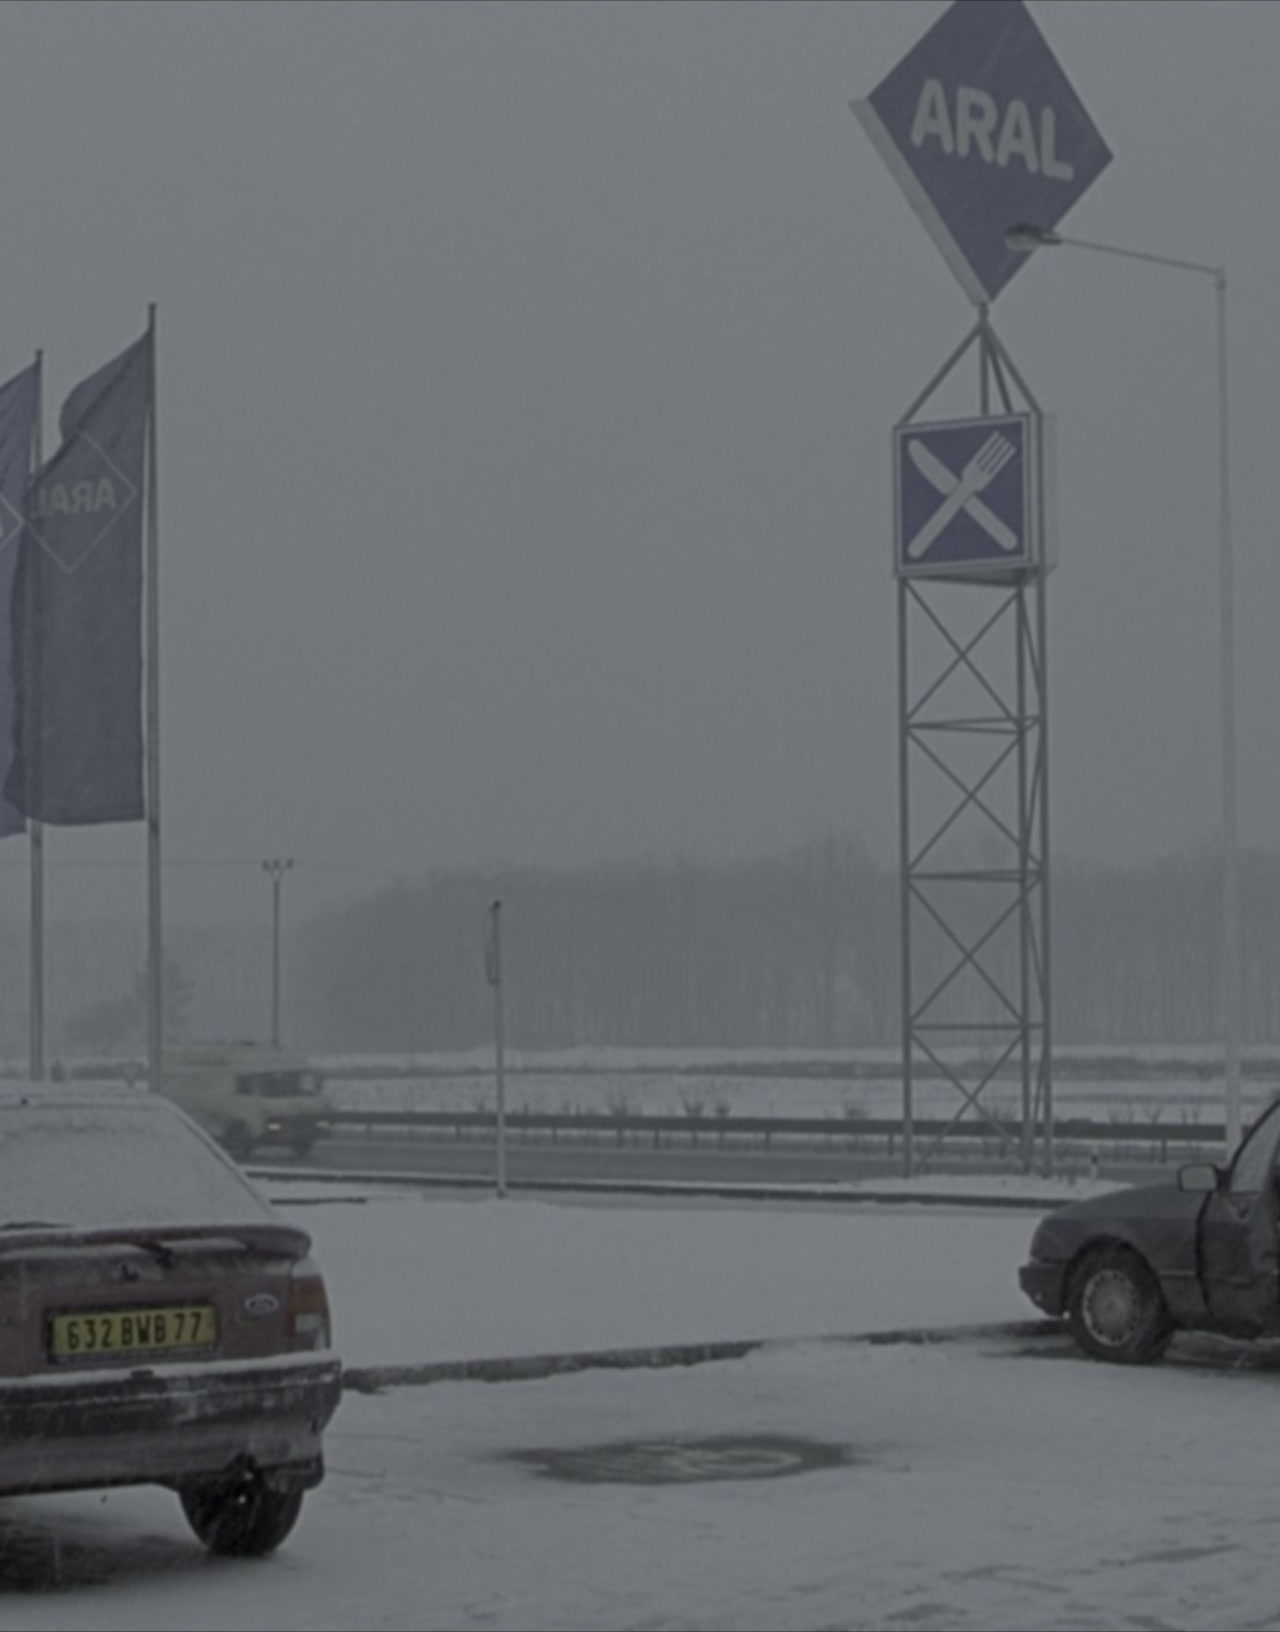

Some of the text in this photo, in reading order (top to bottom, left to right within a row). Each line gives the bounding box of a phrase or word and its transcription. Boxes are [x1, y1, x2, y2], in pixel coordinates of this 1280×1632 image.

[910, 77, 1075, 182] ARAL
[66, 1311, 203, 1351] 632 BWB 77
